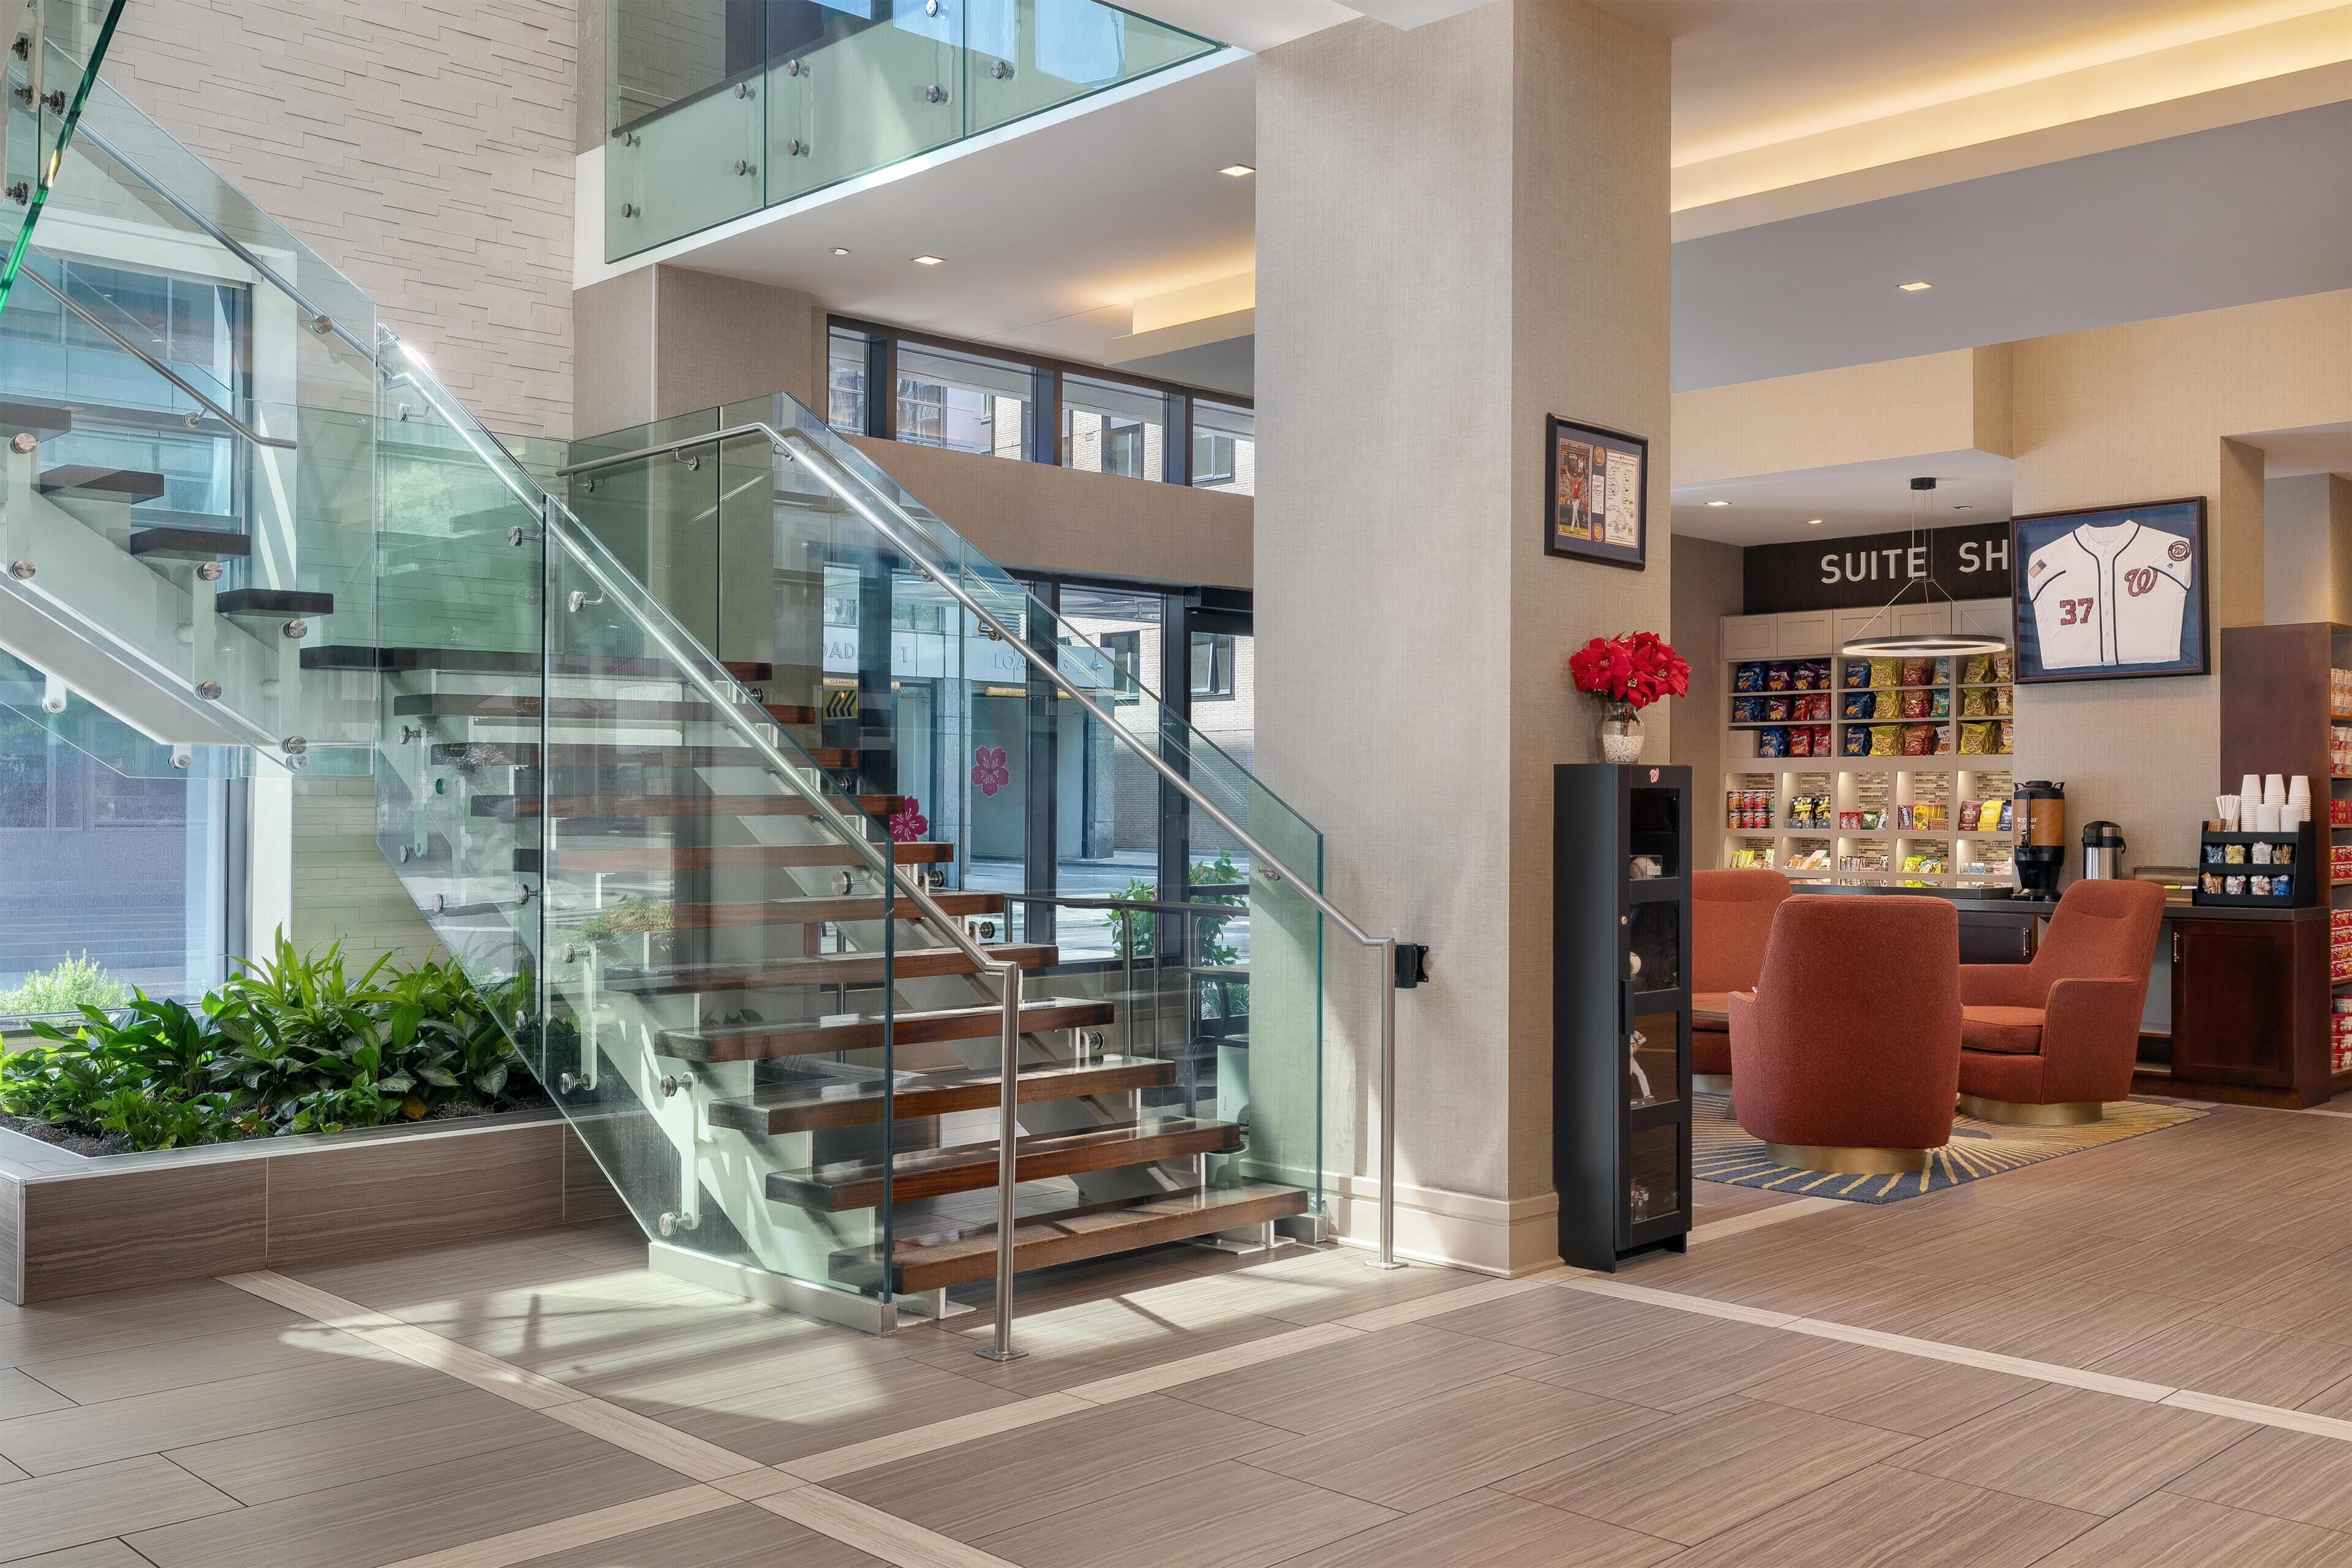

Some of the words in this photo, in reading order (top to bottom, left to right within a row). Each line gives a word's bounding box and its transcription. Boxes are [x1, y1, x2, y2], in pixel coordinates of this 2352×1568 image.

[1820, 546, 1928, 584] SUITE
[2124, 568, 2158, 597] W
[2059, 597, 2094, 626] 37
